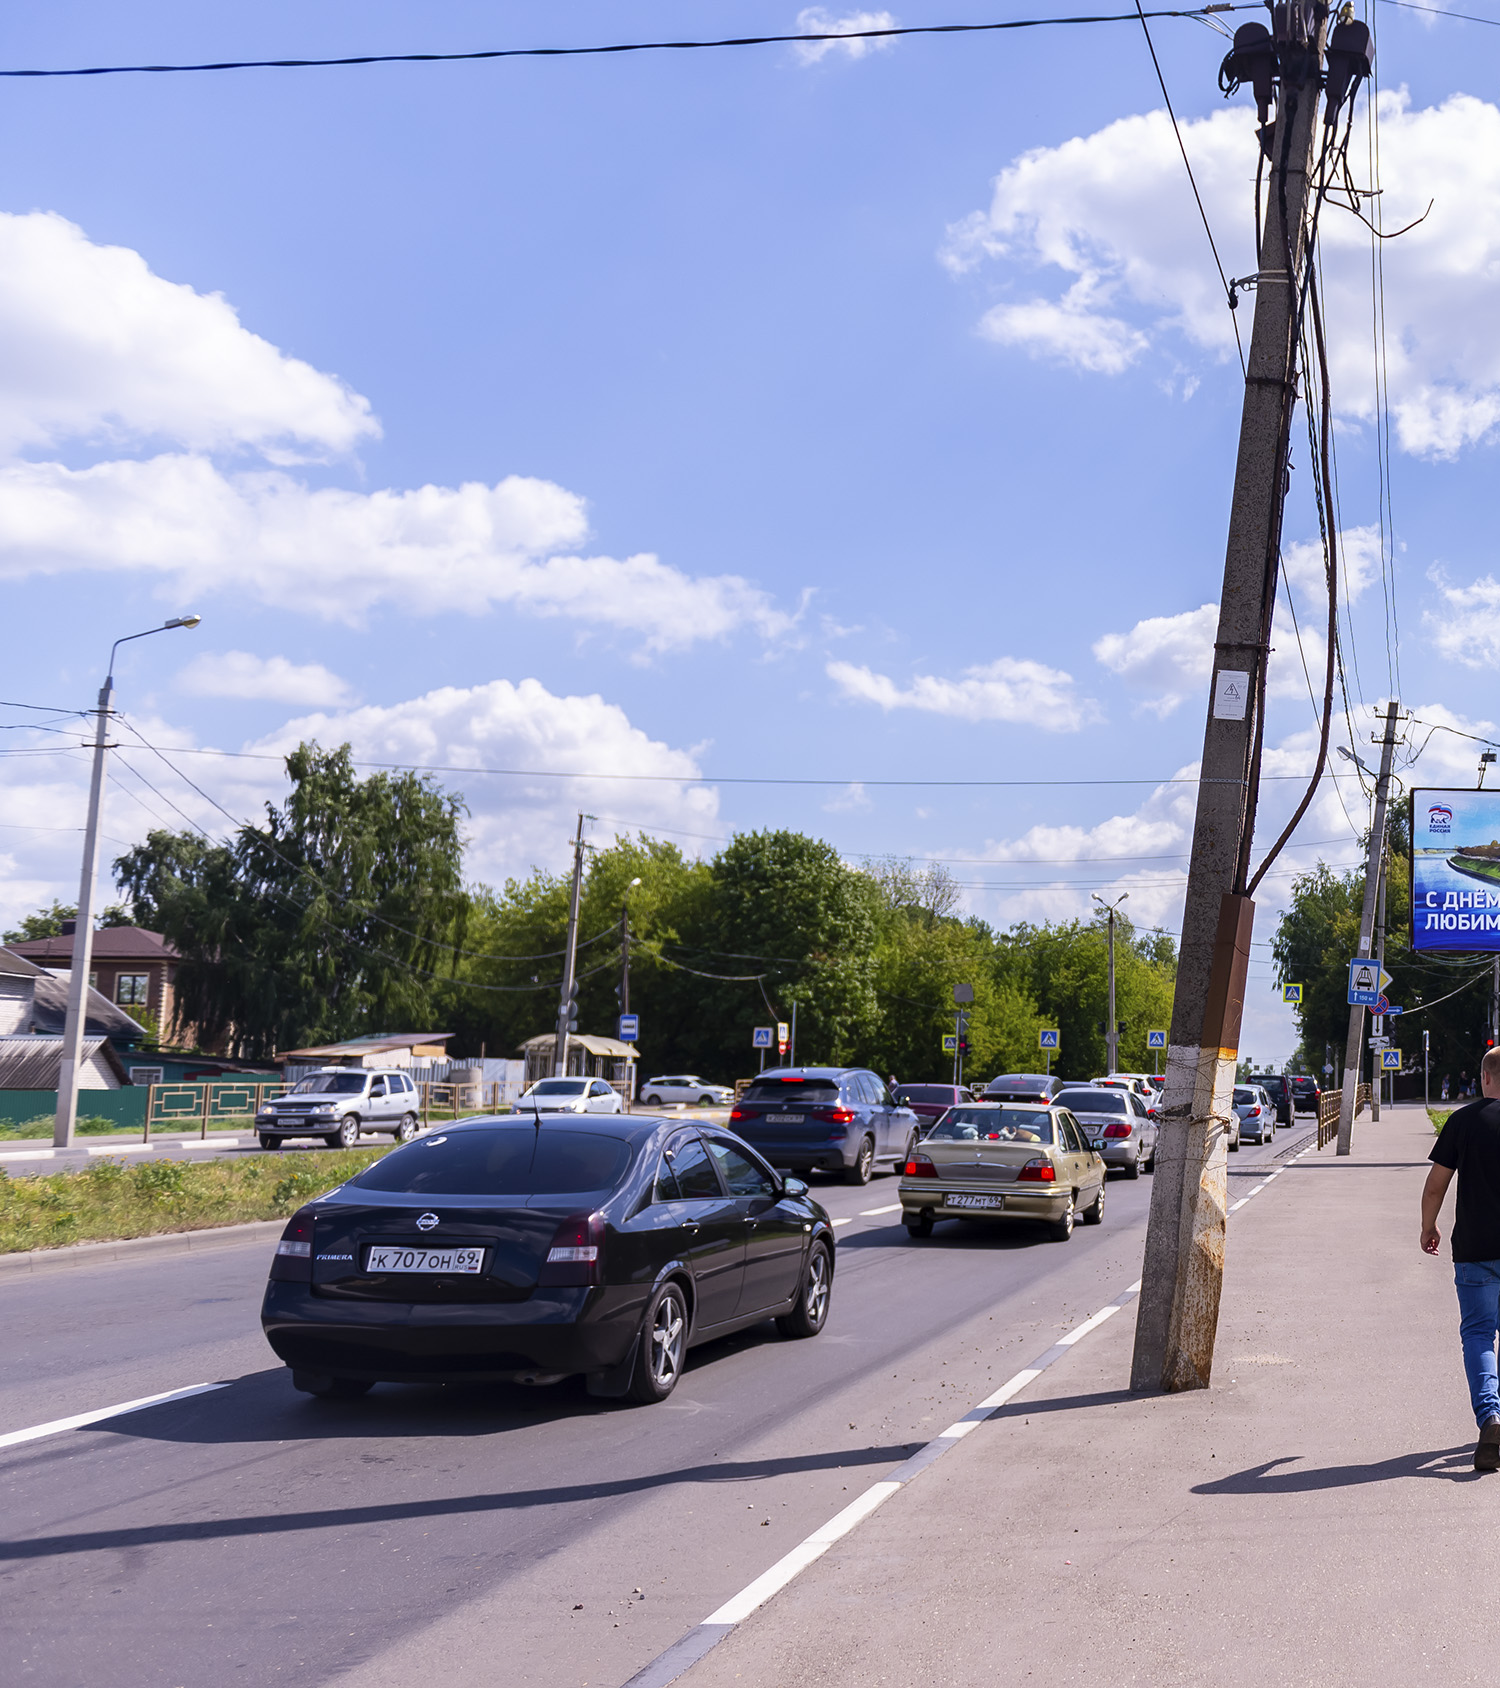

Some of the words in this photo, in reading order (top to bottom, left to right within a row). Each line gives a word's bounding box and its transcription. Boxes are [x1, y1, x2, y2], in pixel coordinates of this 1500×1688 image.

[1426, 891, 1438, 908] С
[316, 1253, 354, 1261] PRIMERA
[456, 1252, 476, 1265] 69
